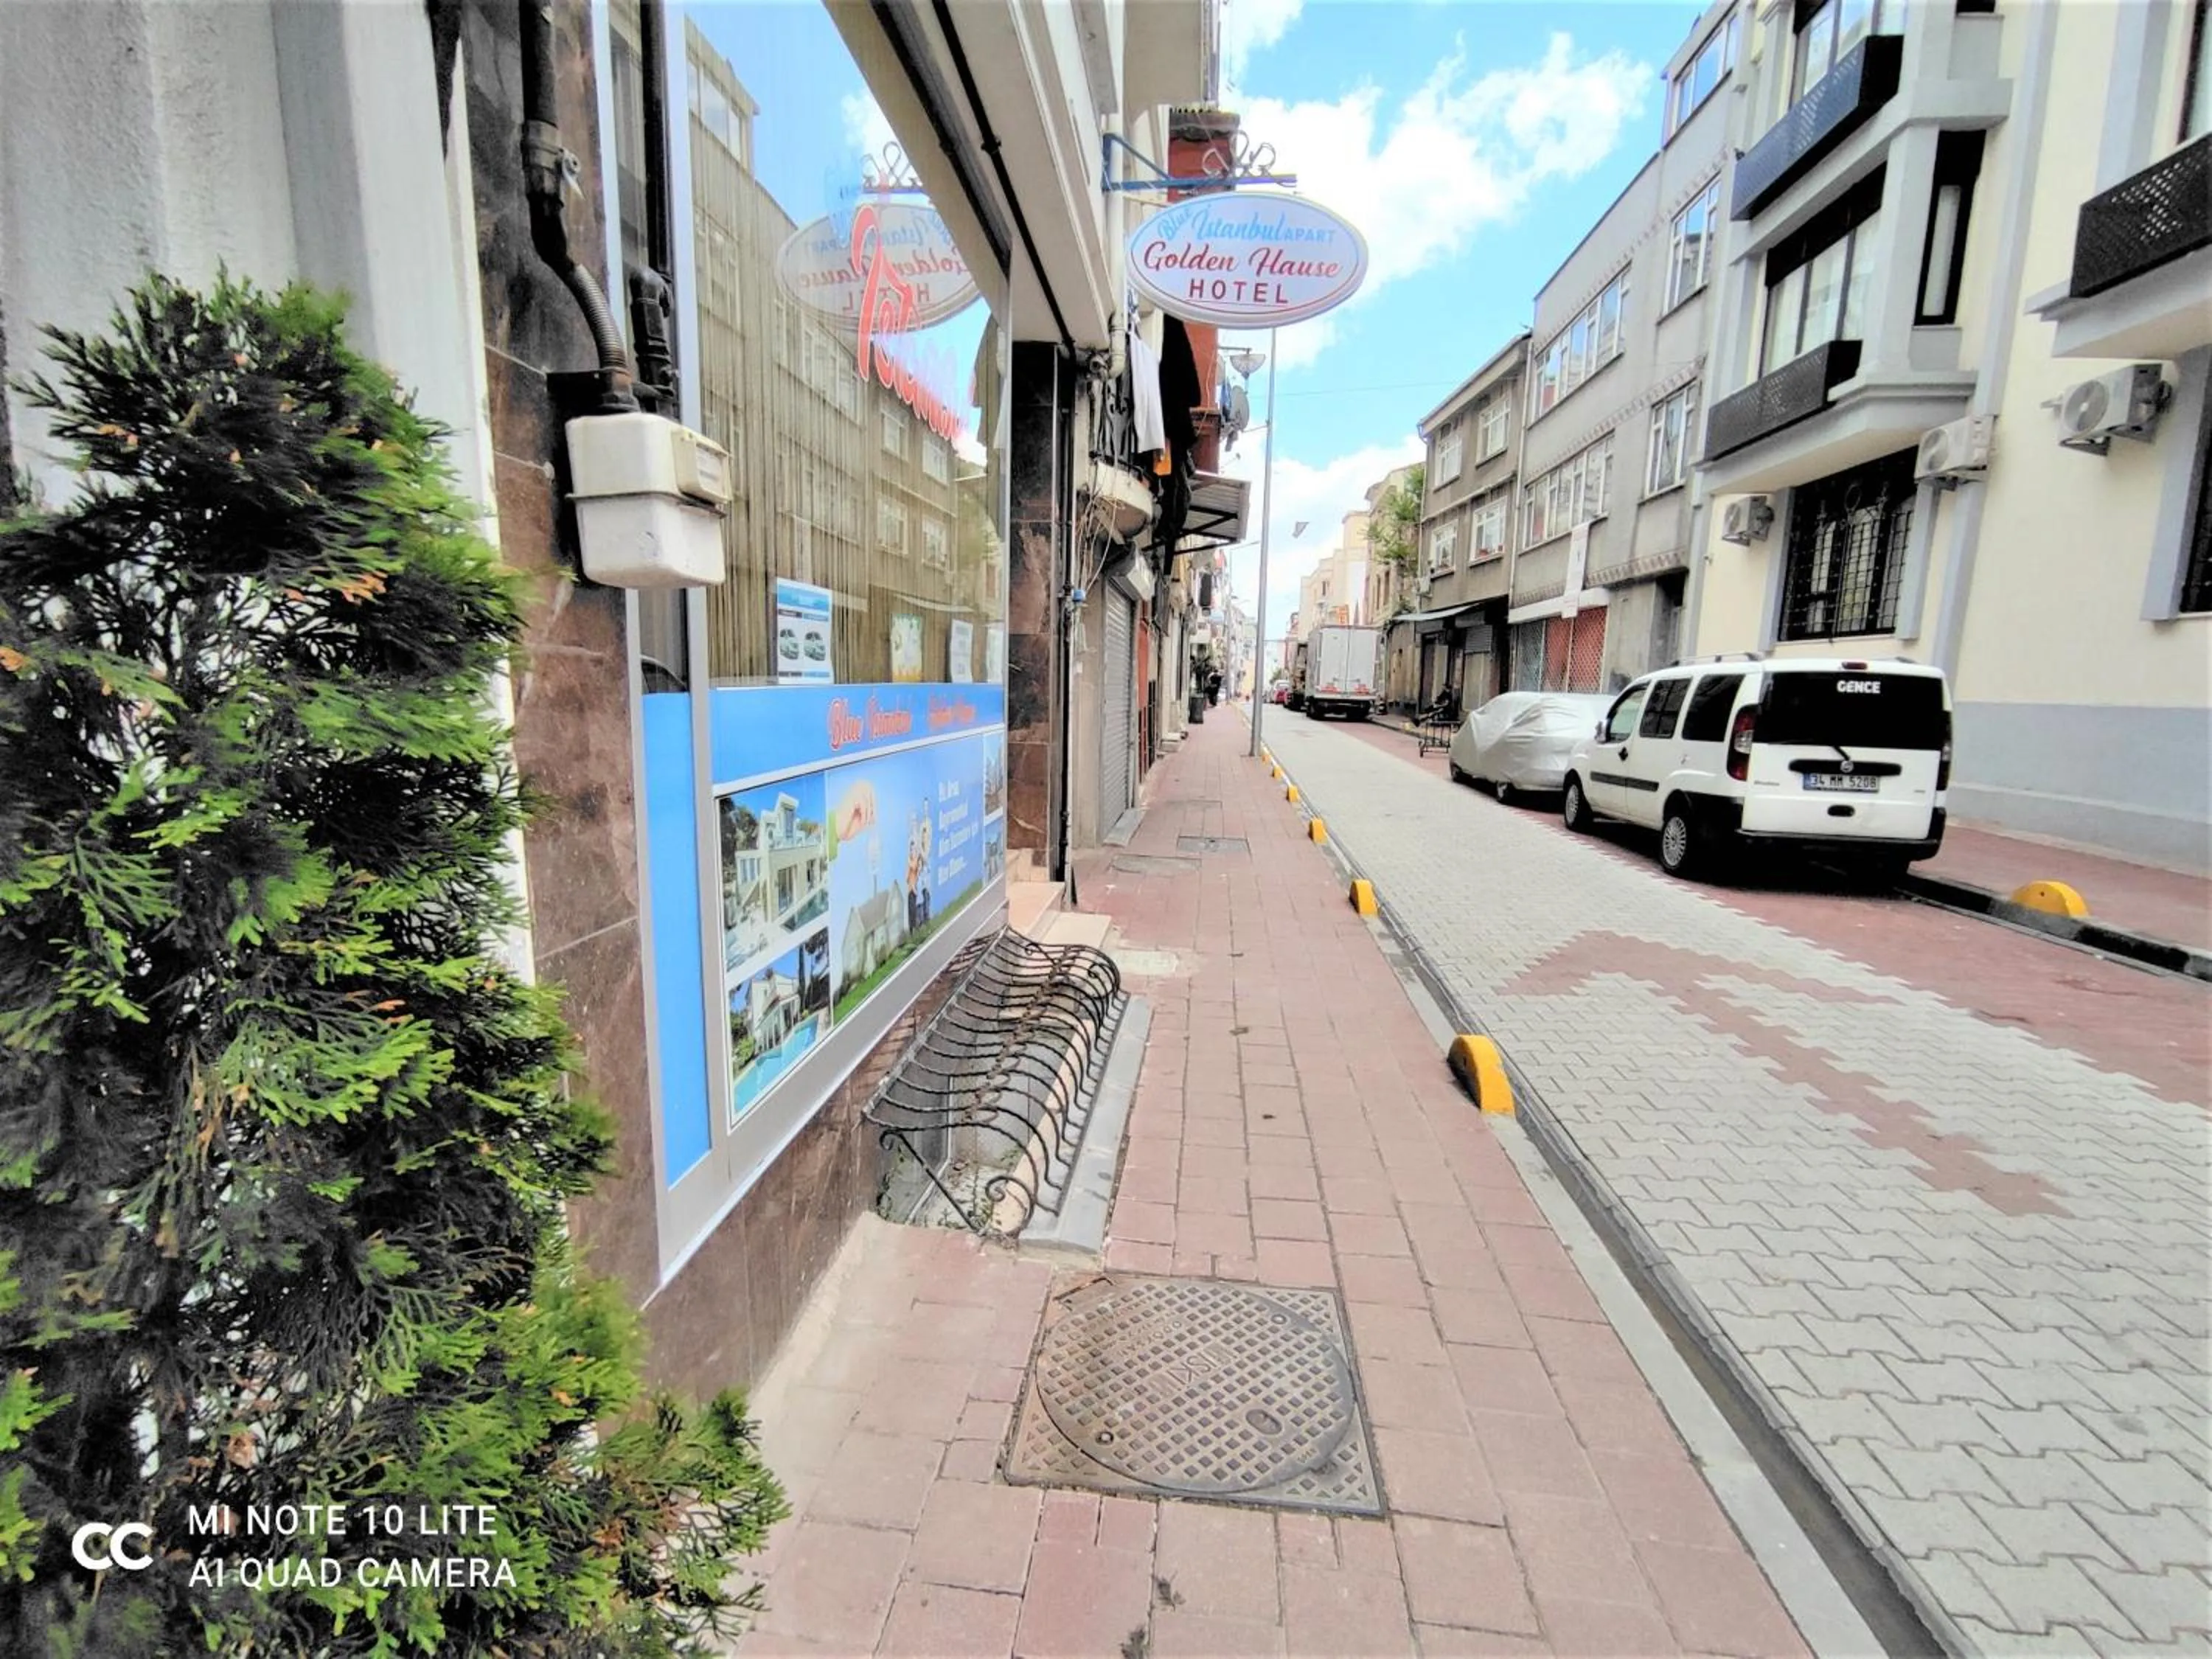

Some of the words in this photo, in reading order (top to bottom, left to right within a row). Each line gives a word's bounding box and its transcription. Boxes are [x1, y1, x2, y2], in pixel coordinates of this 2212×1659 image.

[1158, 208, 1194, 240] Blue
[1284, 228, 1336, 243] APART
[1144, 241, 1239, 272] Golden
[1248, 246, 1343, 278] Hause
[1189, 278, 1290, 304] HOTEL
[1811, 775, 1825, 785] 34
[1830, 775, 1843, 786] MM
